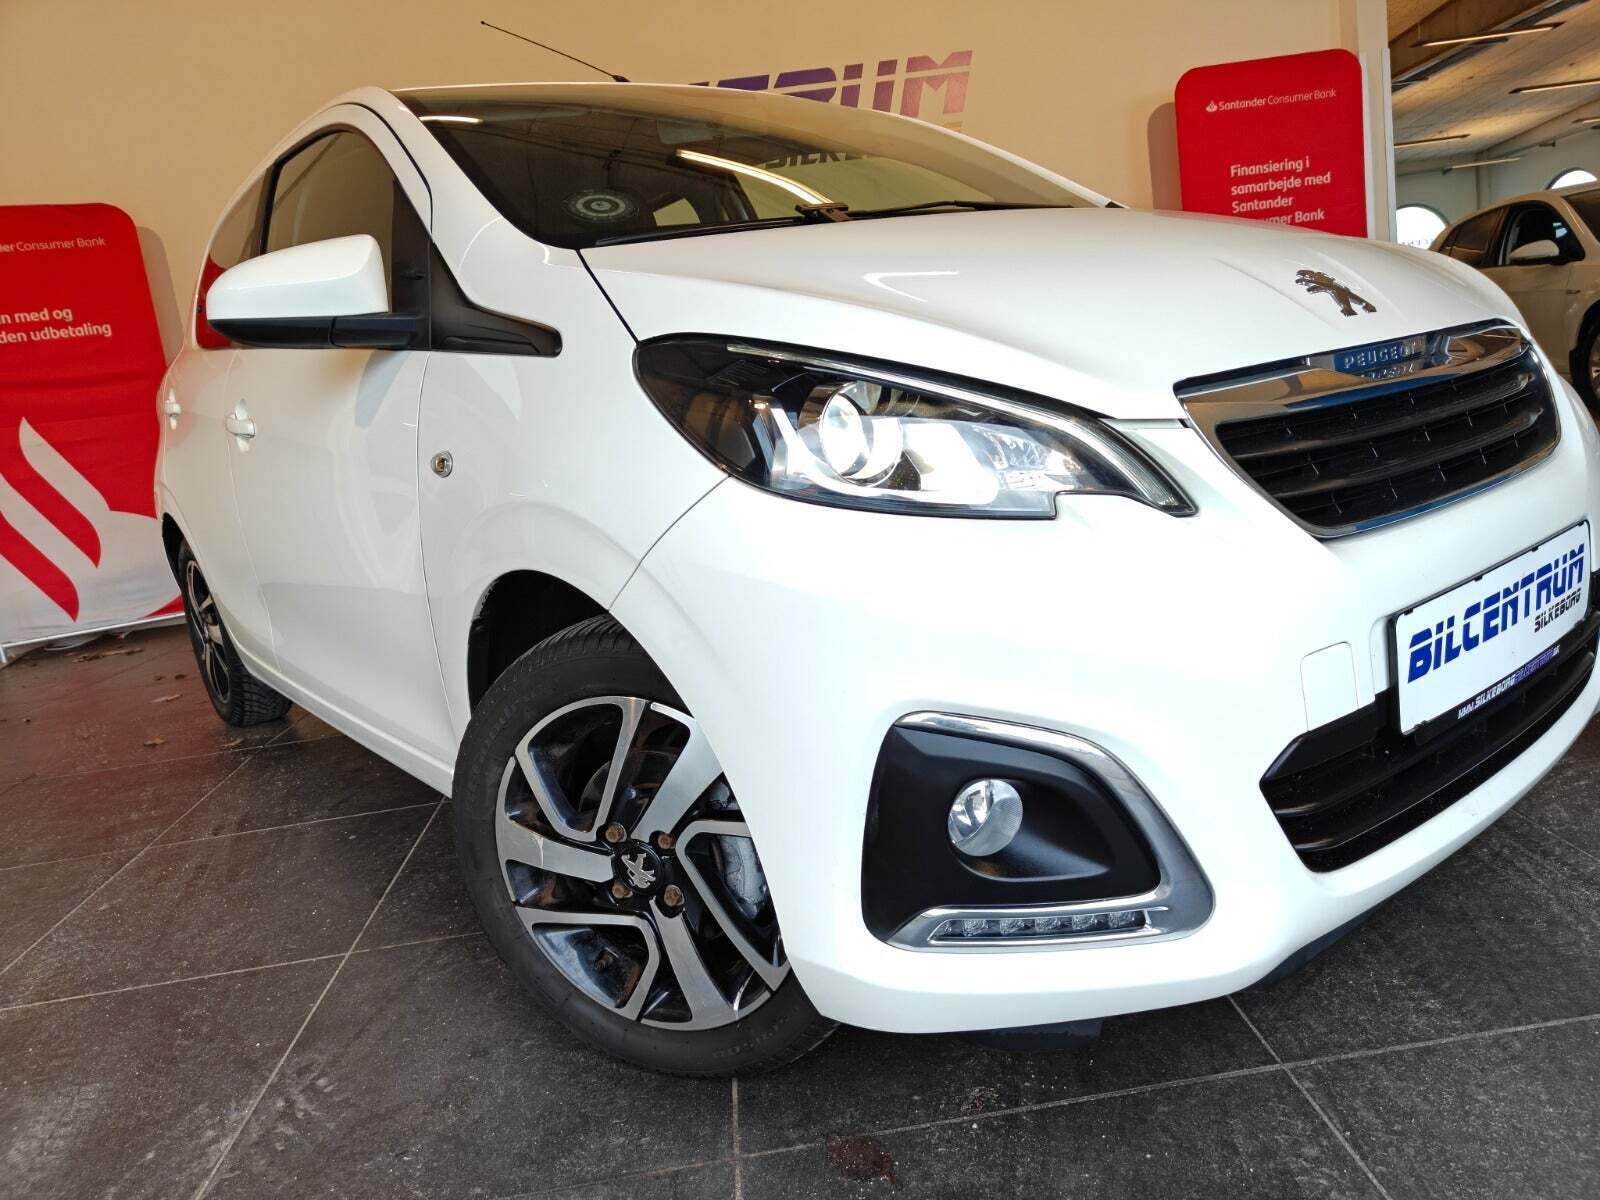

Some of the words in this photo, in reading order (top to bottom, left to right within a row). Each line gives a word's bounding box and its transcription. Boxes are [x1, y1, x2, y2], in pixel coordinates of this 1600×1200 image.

[1218, 98, 1267, 112] Santander
[1267, 91, 1314, 105] Consumer
[1314, 88, 1337, 99] Bank
[1230, 157, 1303, 177] Finansiering
[1305, 155, 1310, 168] i
[1231, 176, 1302, 196] samarbejde
[1304, 172, 1331, 186] med
[1231, 196, 1294, 214] Santander
[1294, 208, 1325, 224] Bank
[16, 239, 75, 251] Consumer
[76, 236, 106, 248] Bank
[14, 307, 49, 323] med
[52, 308, 73, 321] og
[30, 322, 112, 341] udbetaling
[1407, 543, 1585, 684] BILCENTRUM
[1534, 587, 1582, 633] SILKEBORG
